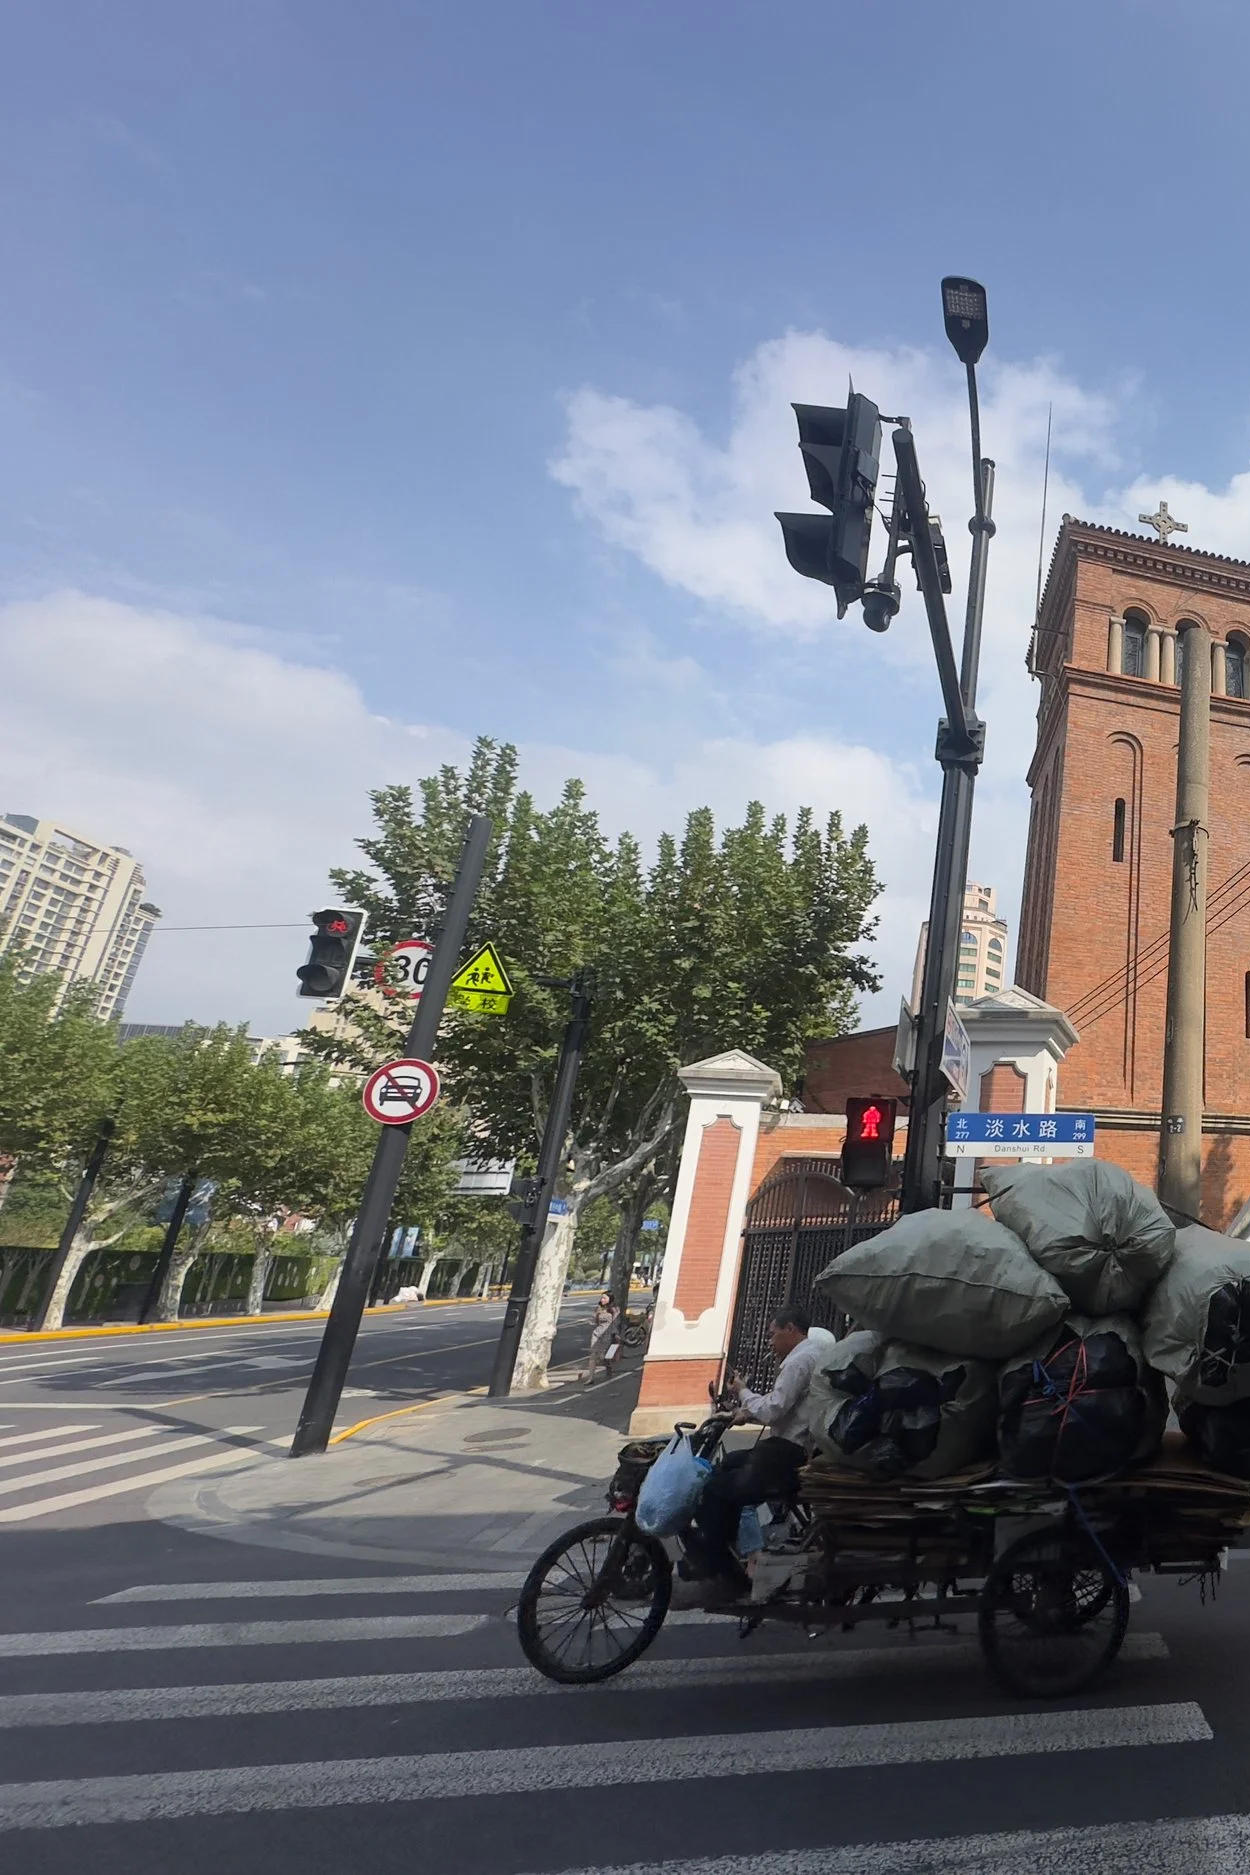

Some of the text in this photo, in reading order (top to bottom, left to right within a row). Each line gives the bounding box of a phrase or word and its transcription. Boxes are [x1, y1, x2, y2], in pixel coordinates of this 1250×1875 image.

[956, 1118, 968, 1130] 北
[985, 1118, 1058, 1139] 淡水路
[1075, 1119, 1086, 1131] 南
[955, 1131, 970, 1140] 277
[1072, 1132, 1087, 1141] 299
[956, 1145, 965, 1154] N
[994, 1144, 1030, 1153] Danshui
[1077, 1145, 1085, 1154] S
